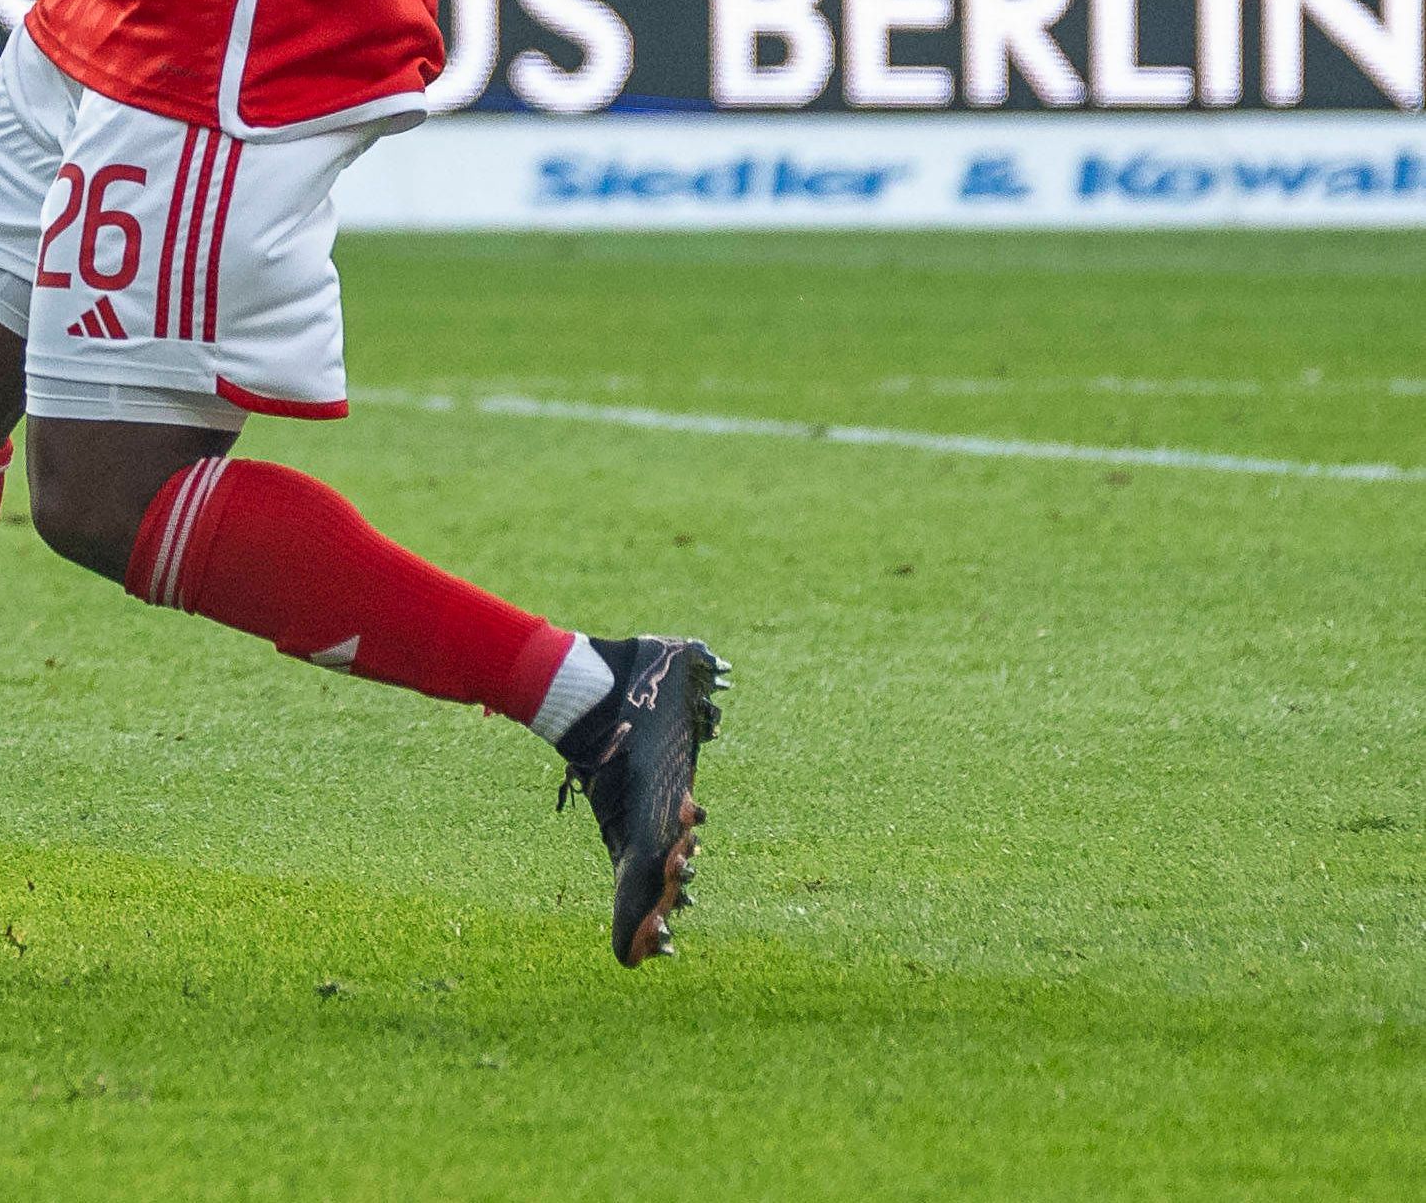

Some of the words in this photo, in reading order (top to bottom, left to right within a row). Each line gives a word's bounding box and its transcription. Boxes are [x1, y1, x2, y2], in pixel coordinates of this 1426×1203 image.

[537, 151, 917, 205] Siedler
[957, 153, 1033, 203] &
[36, 163, 147, 291] 26
